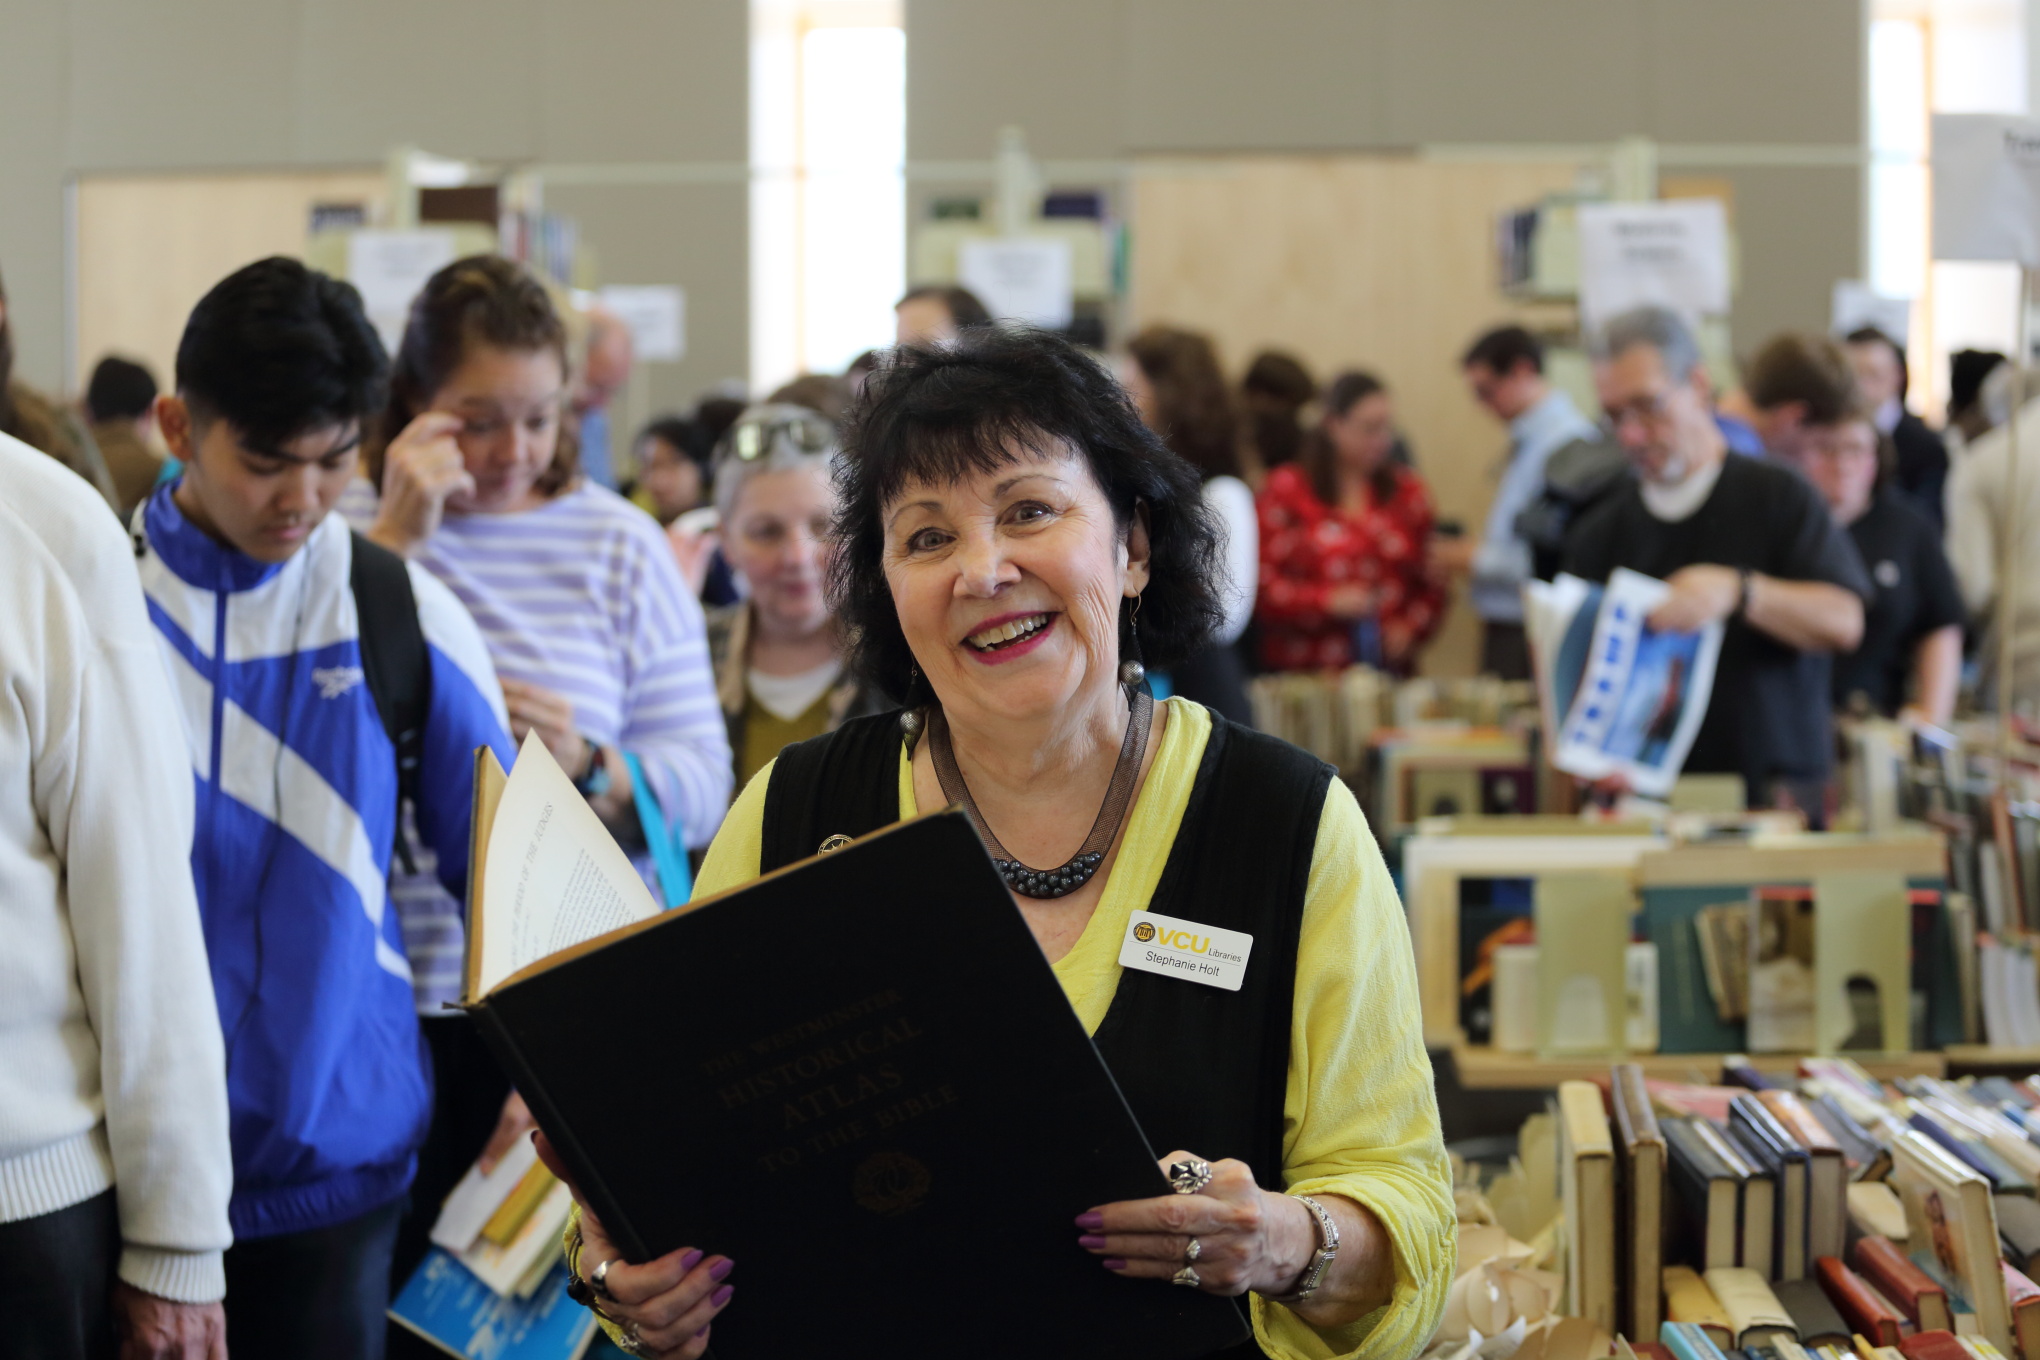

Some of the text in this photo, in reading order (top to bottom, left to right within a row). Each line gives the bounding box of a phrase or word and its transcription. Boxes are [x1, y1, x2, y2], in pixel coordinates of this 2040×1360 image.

[526, 840, 539, 864] THE
[534, 801, 554, 841] JUDGES
[1145, 950, 1220, 977] Stephanie Holt
[1157, 927, 1210, 953] VCU
[1208, 948, 1242, 963] Libraries
[700, 988, 903, 1076] THE WESTMINSTER
[717, 1016, 923, 1109] HISTORICAL
[757, 1084, 960, 1173] TO THE BIBLE
[783, 1062, 904, 1131] ATLAS
